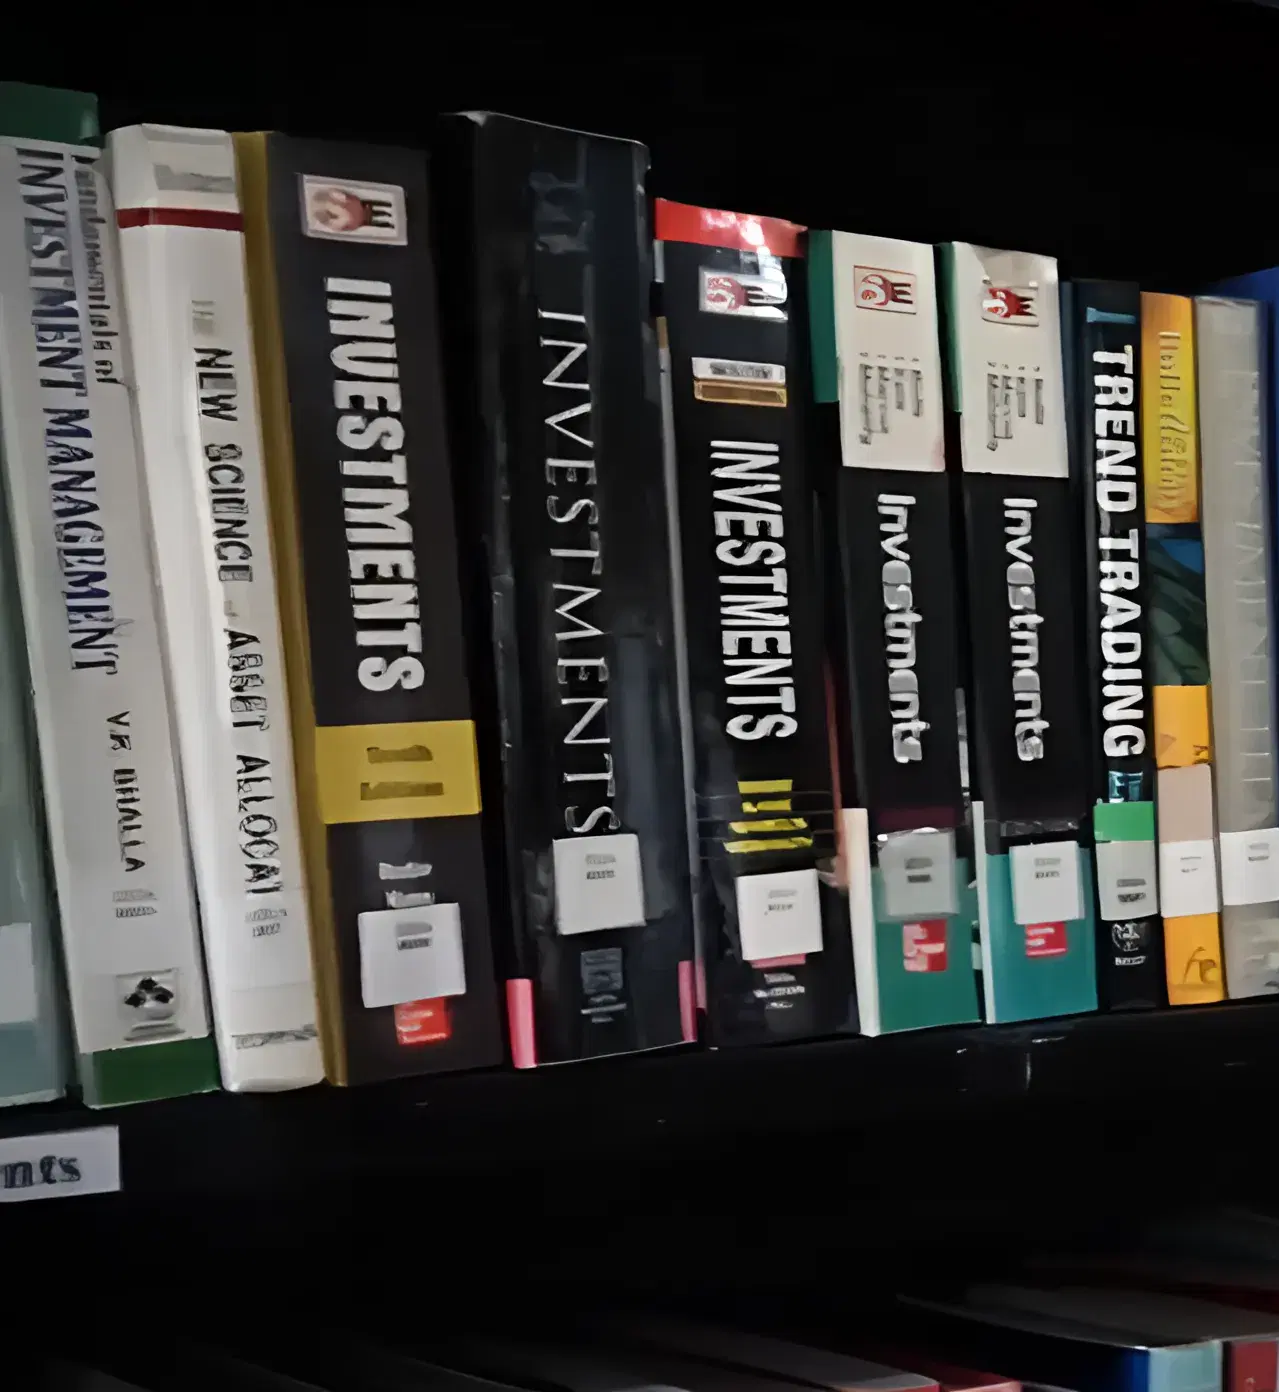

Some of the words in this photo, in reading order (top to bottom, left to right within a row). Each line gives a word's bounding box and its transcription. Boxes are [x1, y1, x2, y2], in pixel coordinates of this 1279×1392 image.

[43, 407, 118, 675] MANAGEMENT
[203, 441, 254, 583] SCIENCE
[324, 275, 425, 691] INVESTMENTS
[1092, 344, 1139, 513] TREND
[537, 307, 622, 833] INVESTMENTS
[709, 439, 799, 741] INVESTMENTS
[877, 494, 931, 763] Investments
[1003, 497, 1051, 762] Investments
[1097, 528, 1147, 757] TRADING
